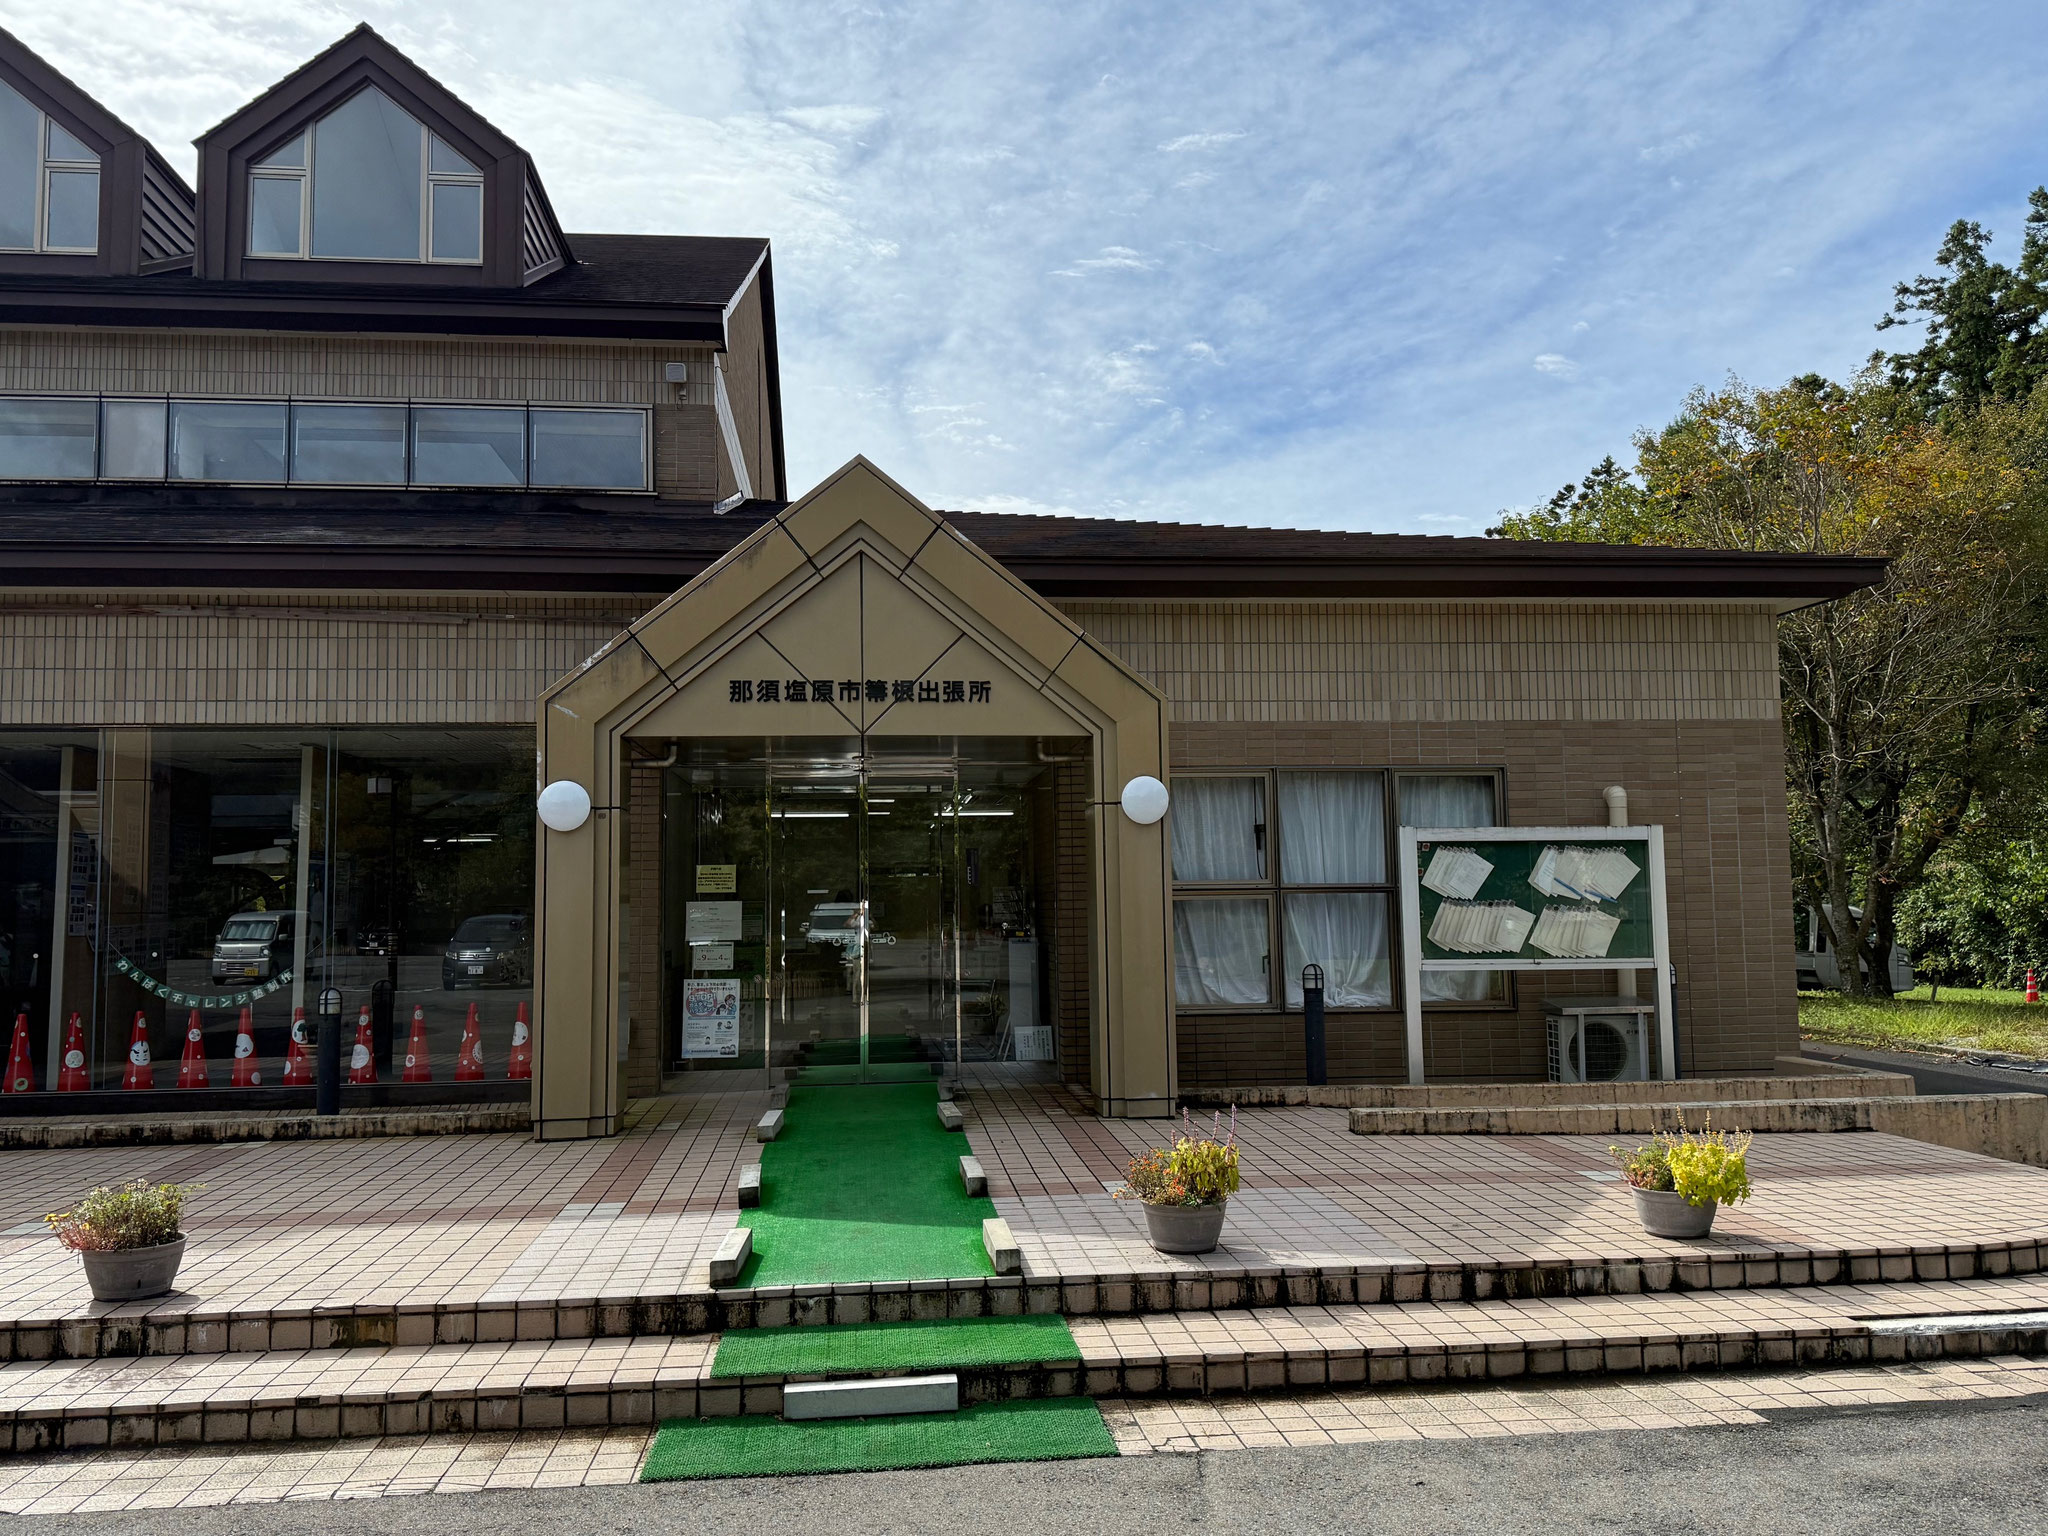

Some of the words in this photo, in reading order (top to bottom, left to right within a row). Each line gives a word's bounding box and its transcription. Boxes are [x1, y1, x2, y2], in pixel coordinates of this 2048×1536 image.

[729, 679, 992, 703] 那須塩原市箒根出張所
